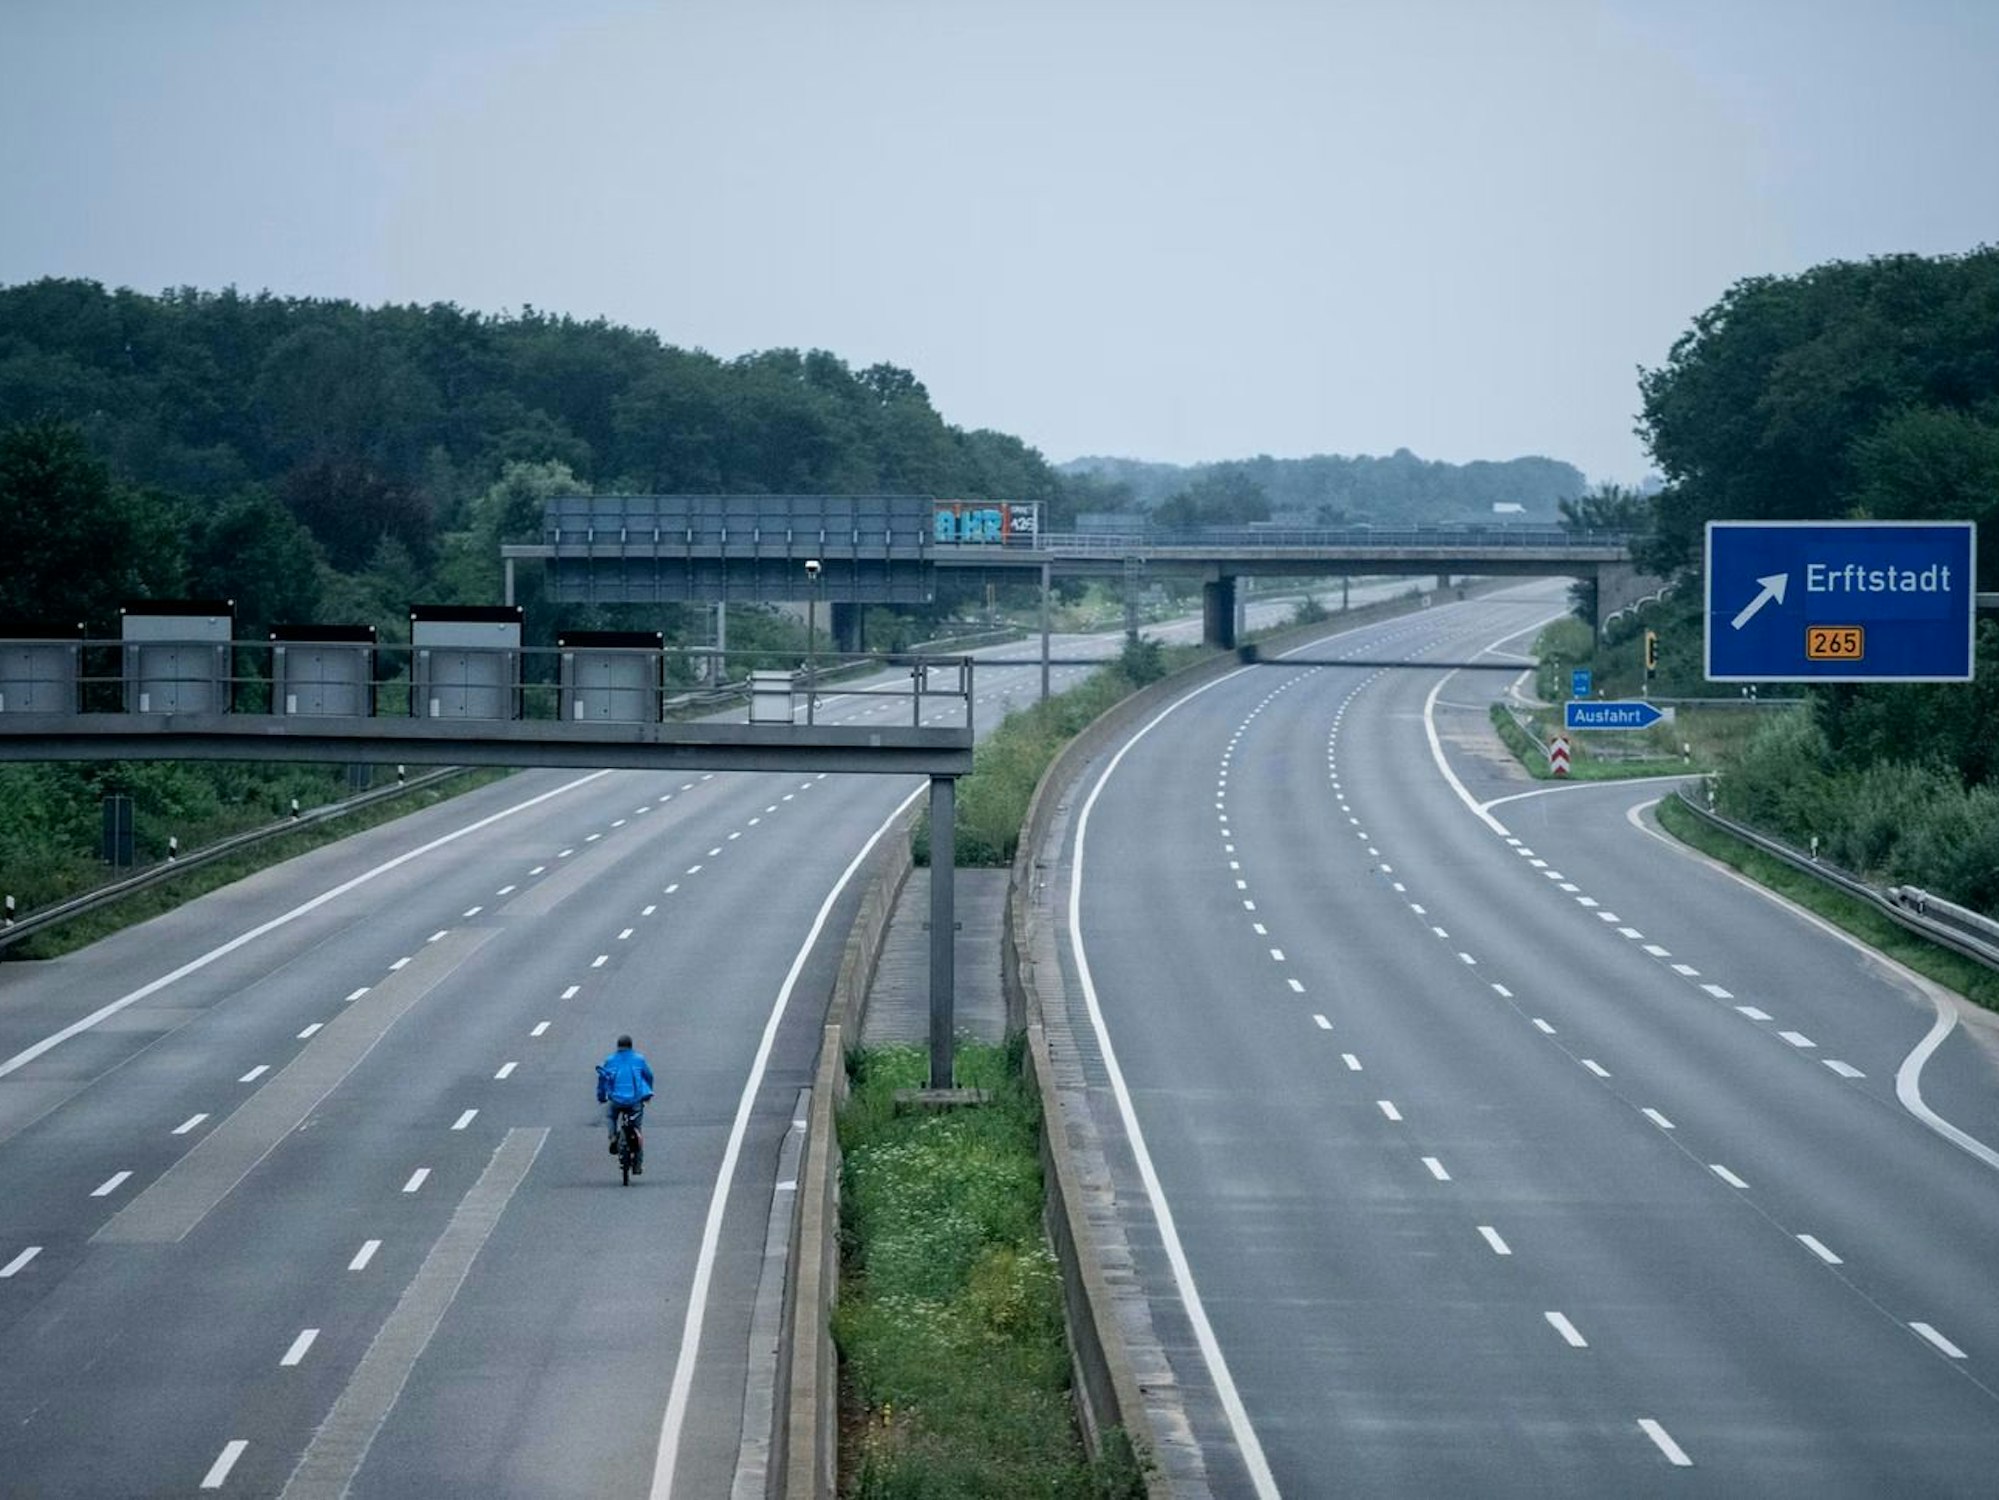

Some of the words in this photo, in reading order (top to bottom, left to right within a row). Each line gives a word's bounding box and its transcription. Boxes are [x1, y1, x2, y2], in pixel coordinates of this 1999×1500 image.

[1807, 564, 1951, 592] Erftstadt
[1814, 633, 1857, 653] 265
[1574, 708, 1641, 723] Ausfahrt
